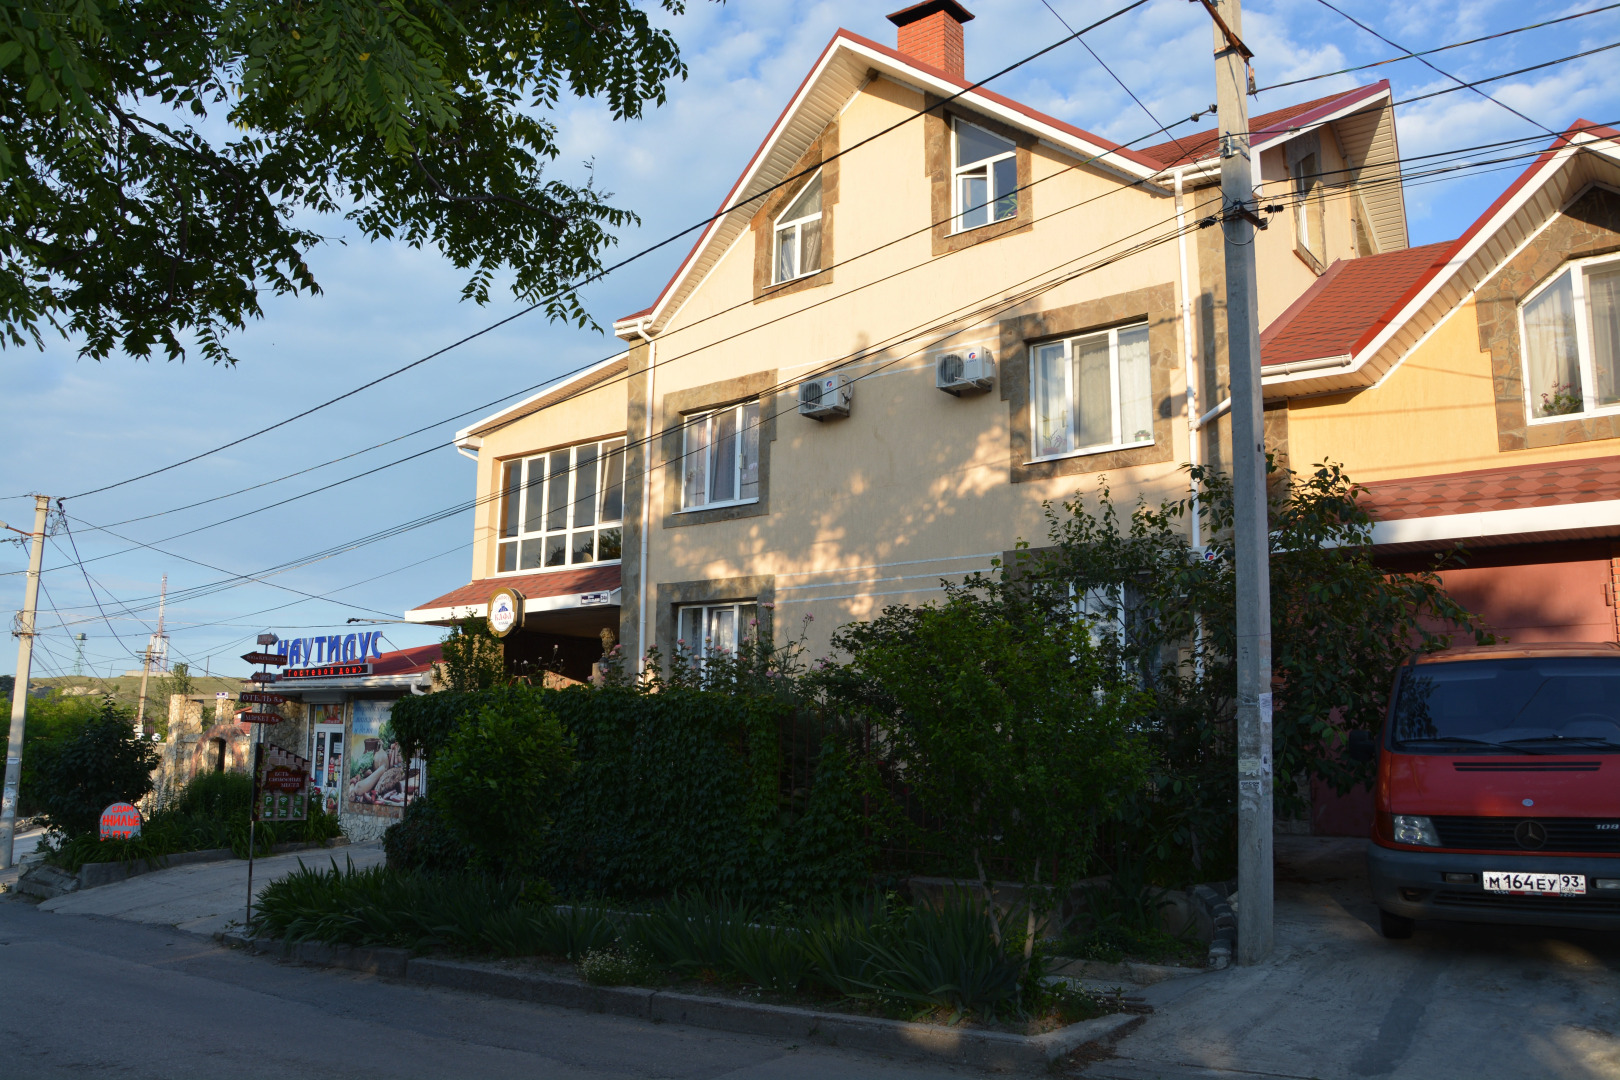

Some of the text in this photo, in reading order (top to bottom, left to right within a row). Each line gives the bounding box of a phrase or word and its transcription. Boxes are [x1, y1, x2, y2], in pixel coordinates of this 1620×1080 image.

[277, 631, 383, 669] НАУТИЛУС
[242, 694, 272, 702] ОТЕЛЬ
[245, 713, 268, 722] МАРКЕТ
[112, 805, 133, 813] СДАМ
[102, 813, 140, 826] ЖИЛЬЁ
